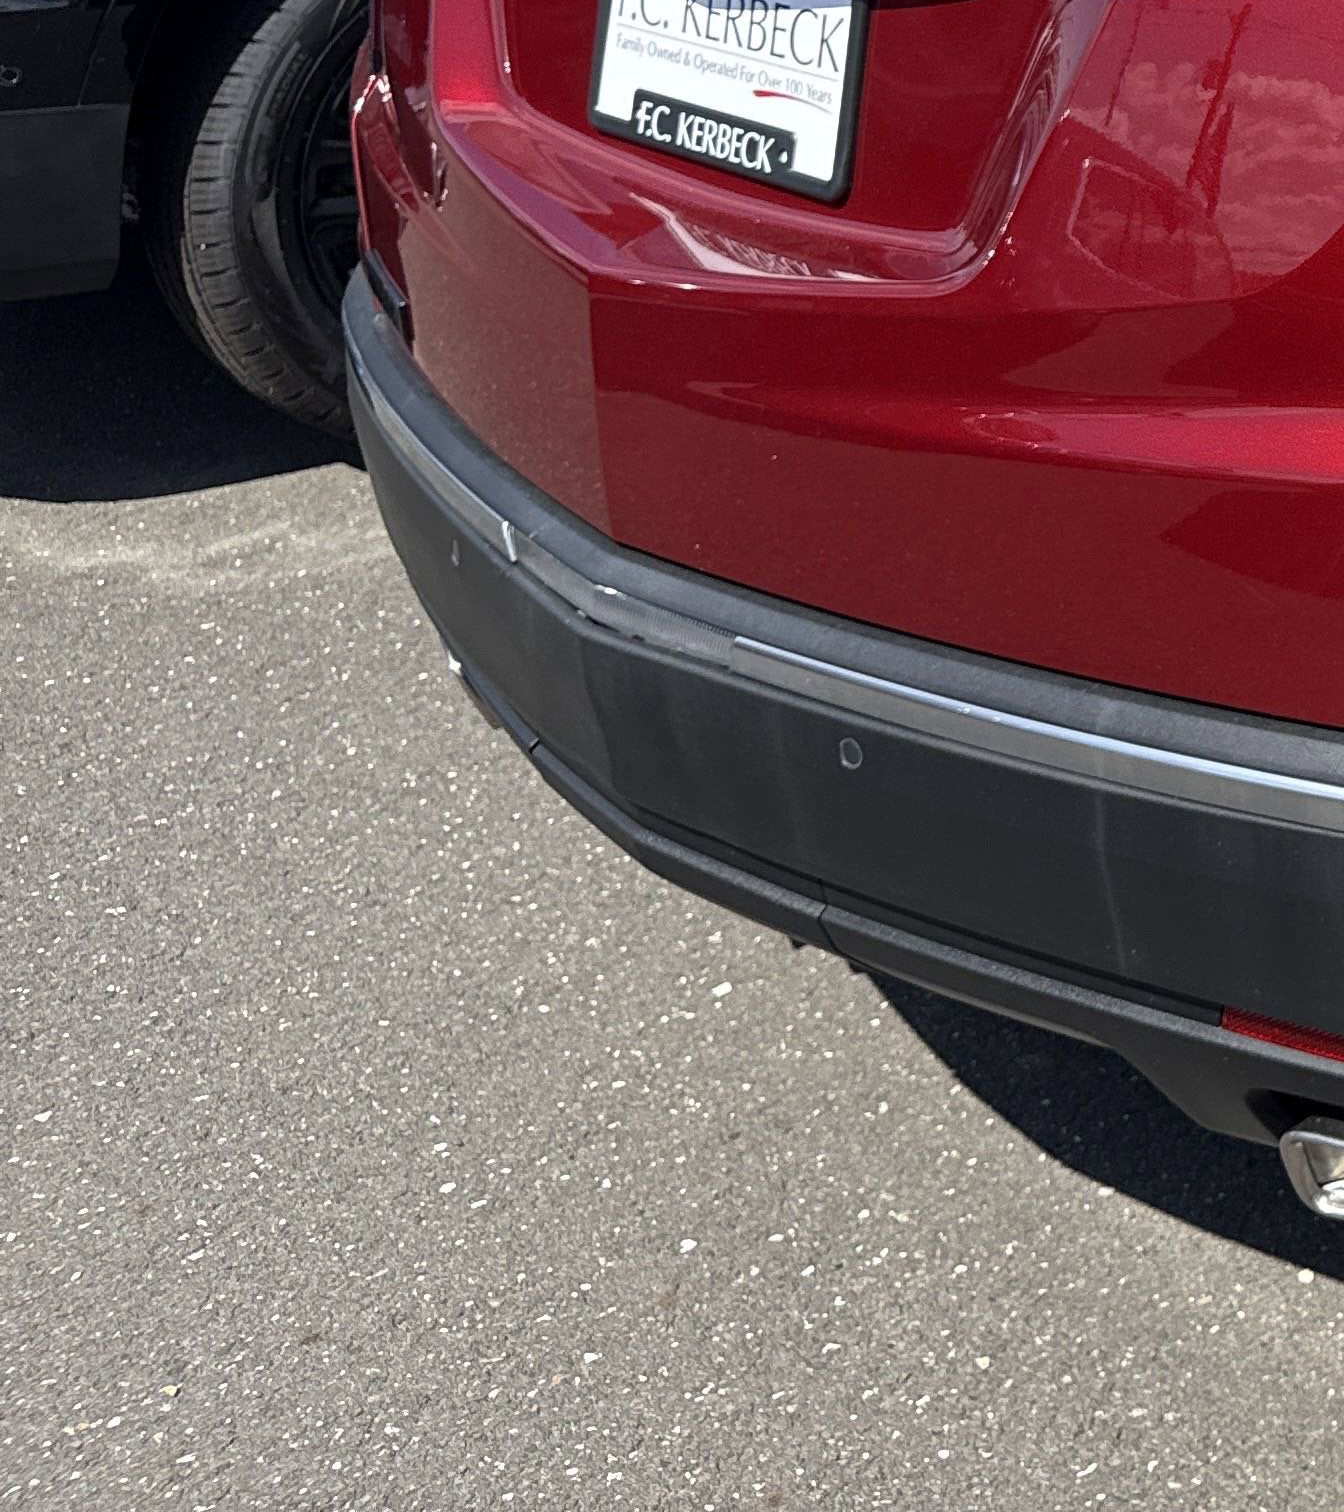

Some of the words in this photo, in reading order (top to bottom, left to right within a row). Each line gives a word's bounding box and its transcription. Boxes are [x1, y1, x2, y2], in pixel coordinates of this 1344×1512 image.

[616, 33, 645, 58] Family
[647, 41, 682, 65] Owned
[683, 50, 691, 67] &
[693, 53, 738, 80] Operated
[740, 64, 756, 82] For
[758, 70, 783, 88] Over
[785, 78, 804, 96] 100
[806, 83, 833, 105] Years
[636, 100, 671, 143] F.C.
[676, 112, 775, 174] KERBECK
